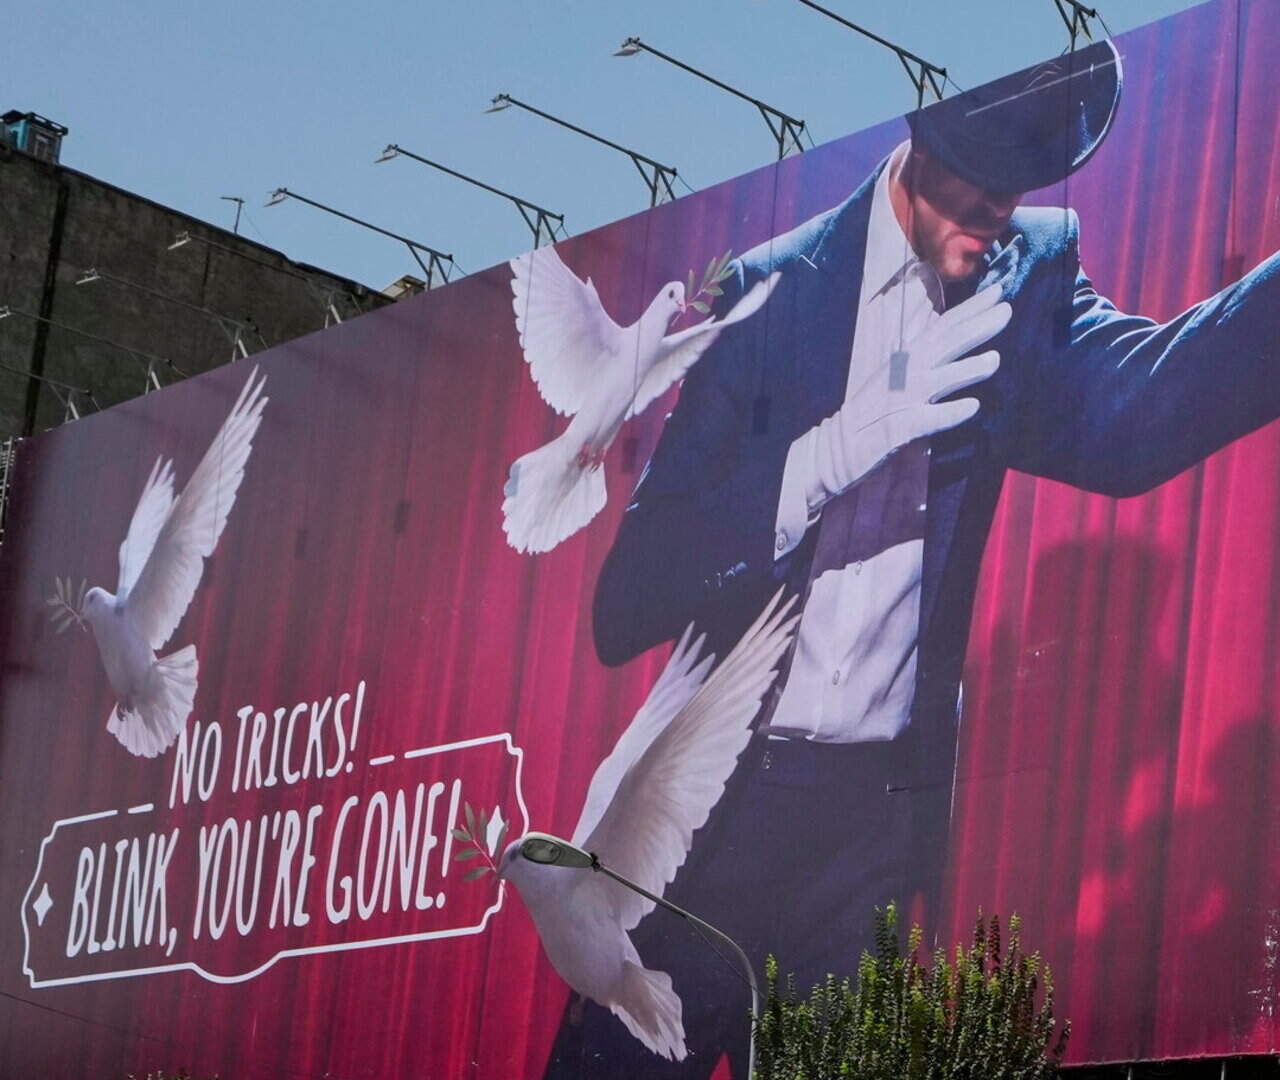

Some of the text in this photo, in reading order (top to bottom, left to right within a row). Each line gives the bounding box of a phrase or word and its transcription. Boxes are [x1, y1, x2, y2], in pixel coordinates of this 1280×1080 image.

[169, 681, 365, 808] NO TRICKS!
[66, 779, 462, 957] BLINK, YOU'RE GONE!
